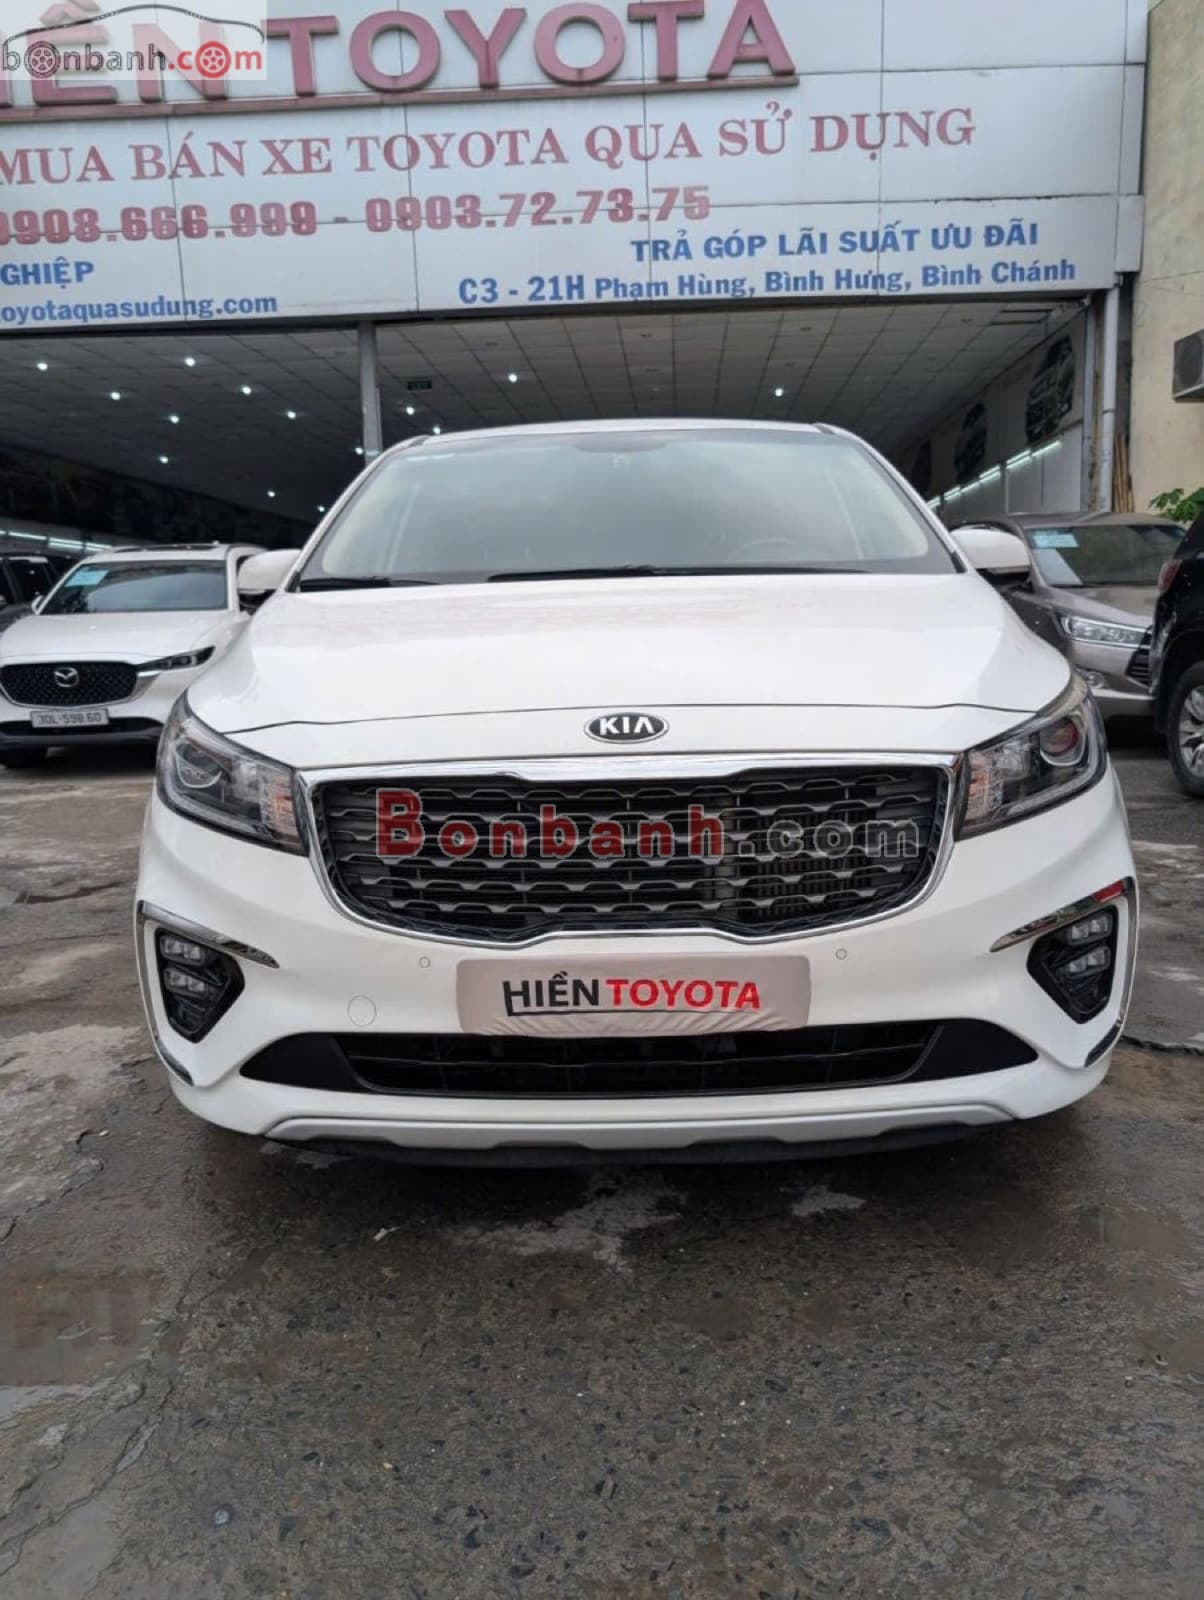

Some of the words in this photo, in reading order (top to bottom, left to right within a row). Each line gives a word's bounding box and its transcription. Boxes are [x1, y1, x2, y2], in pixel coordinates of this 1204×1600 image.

[261, 0, 796, 98] TOYOTA
[0, 146, 114, 185] MUA
[128, 131, 247, 181] BÁN
[259, 138, 333, 176] XE
[346, 127, 569, 172] TOYOTA
[584, 121, 702, 170] QUA
[718, 101, 794, 156] SỬ
[809, 107, 976, 161] DỤNG
[365, 185, 711, 233] 0903.72.73.75
[630, 230, 693, 262] TRẢ
[703, 228, 768, 259] GÓP
[778, 227, 828, 257] LÃI
[839, 220, 921, 254] SUẤT
[931, 222, 973, 250] ƯU
[984, 218, 1039, 248] ĐÃI
[458, 277, 499, 304] C3
[527, 275, 586, 301] 21H
[595, 277, 669, 302] Phạm
[677, 273, 756, 299] Hùng,
[765, 269, 824, 293] Bình
[834, 267, 912, 293] Hưng,
[922, 263, 982, 288] Bình
[991, 258, 1076, 284] Chánh
[0, 295, 278, 326] oyotaquasudung.com
[600, 716, 656, 736] KIA
[502, 971, 599, 1016] HIỀN
[606, 978, 761, 1010] TOYOTA
